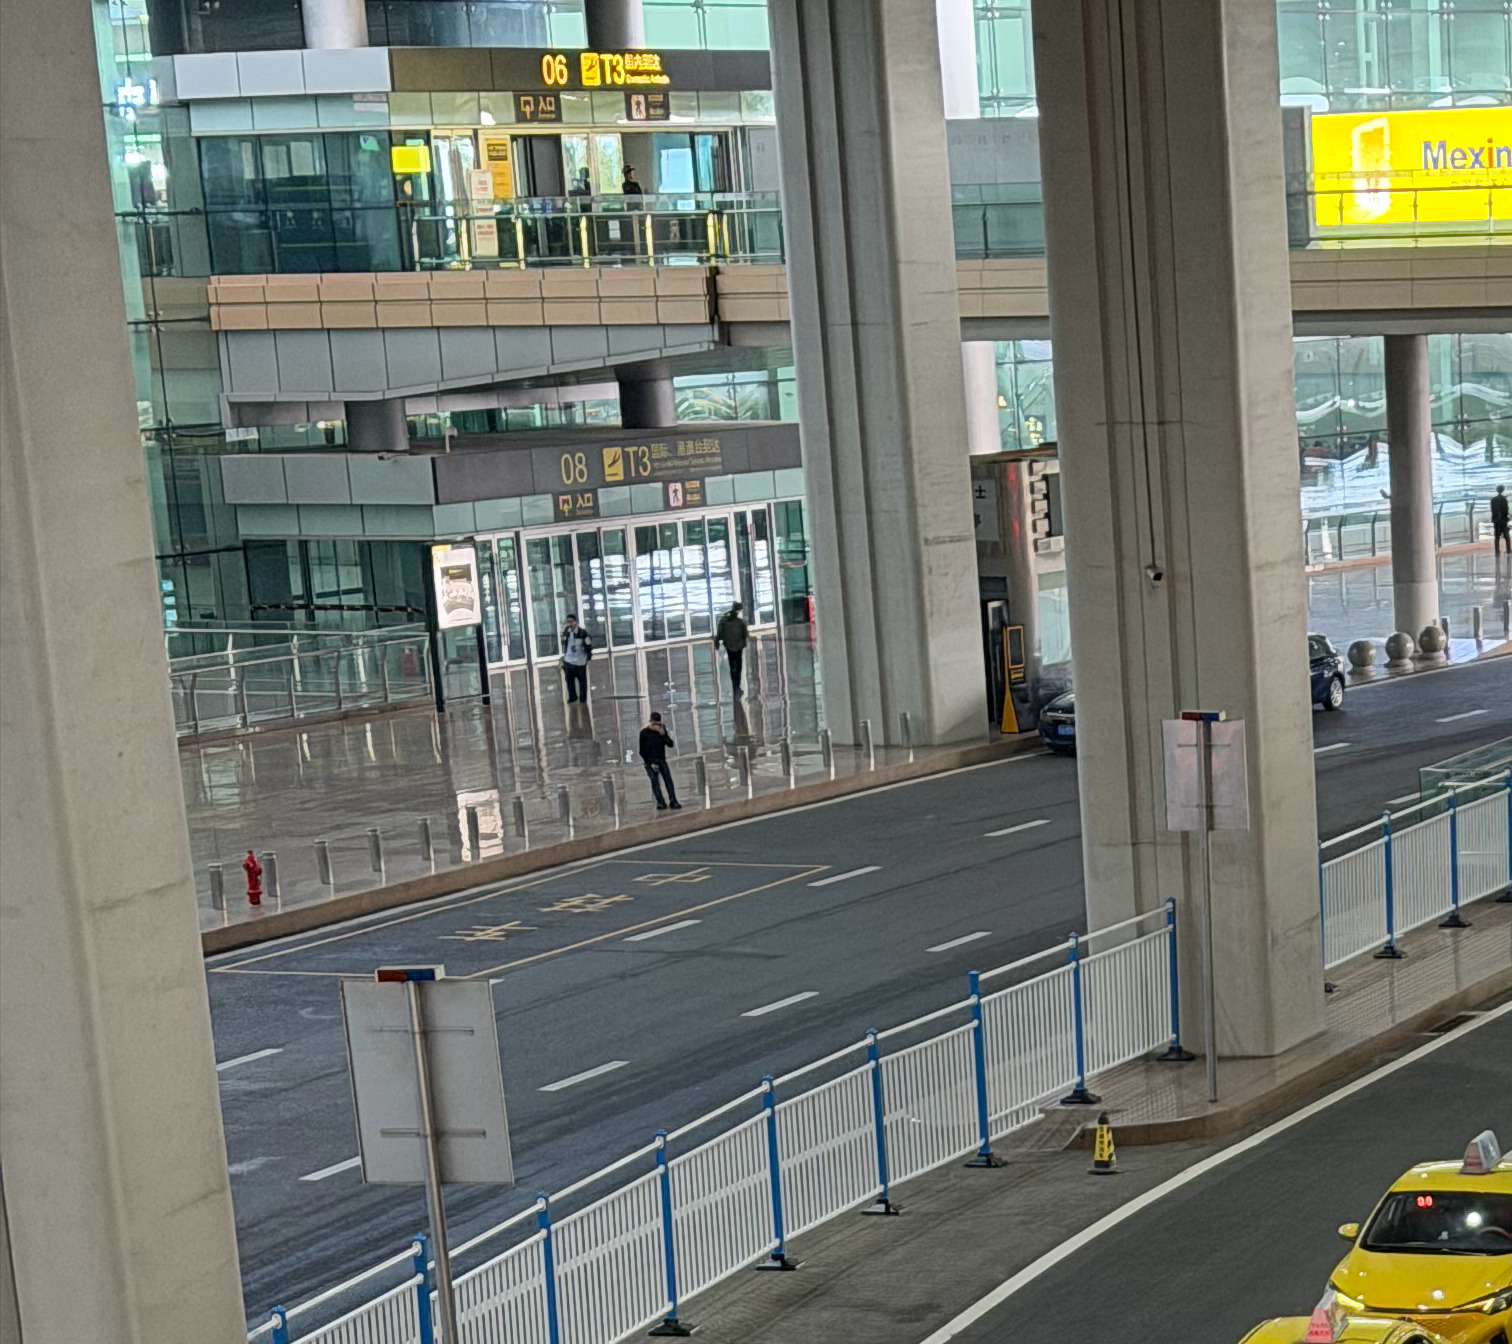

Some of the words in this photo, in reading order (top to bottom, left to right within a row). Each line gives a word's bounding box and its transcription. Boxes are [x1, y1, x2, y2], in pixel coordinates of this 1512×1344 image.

[542, 54, 568, 85] 06
[600, 53, 625, 85] T3
[538, 96, 555, 112] 入口
[1422, 138, 1512, 170] Mexin
[560, 452, 588, 485] 08
[624, 446, 650, 477] T3
[576, 493, 593, 508] 入口
